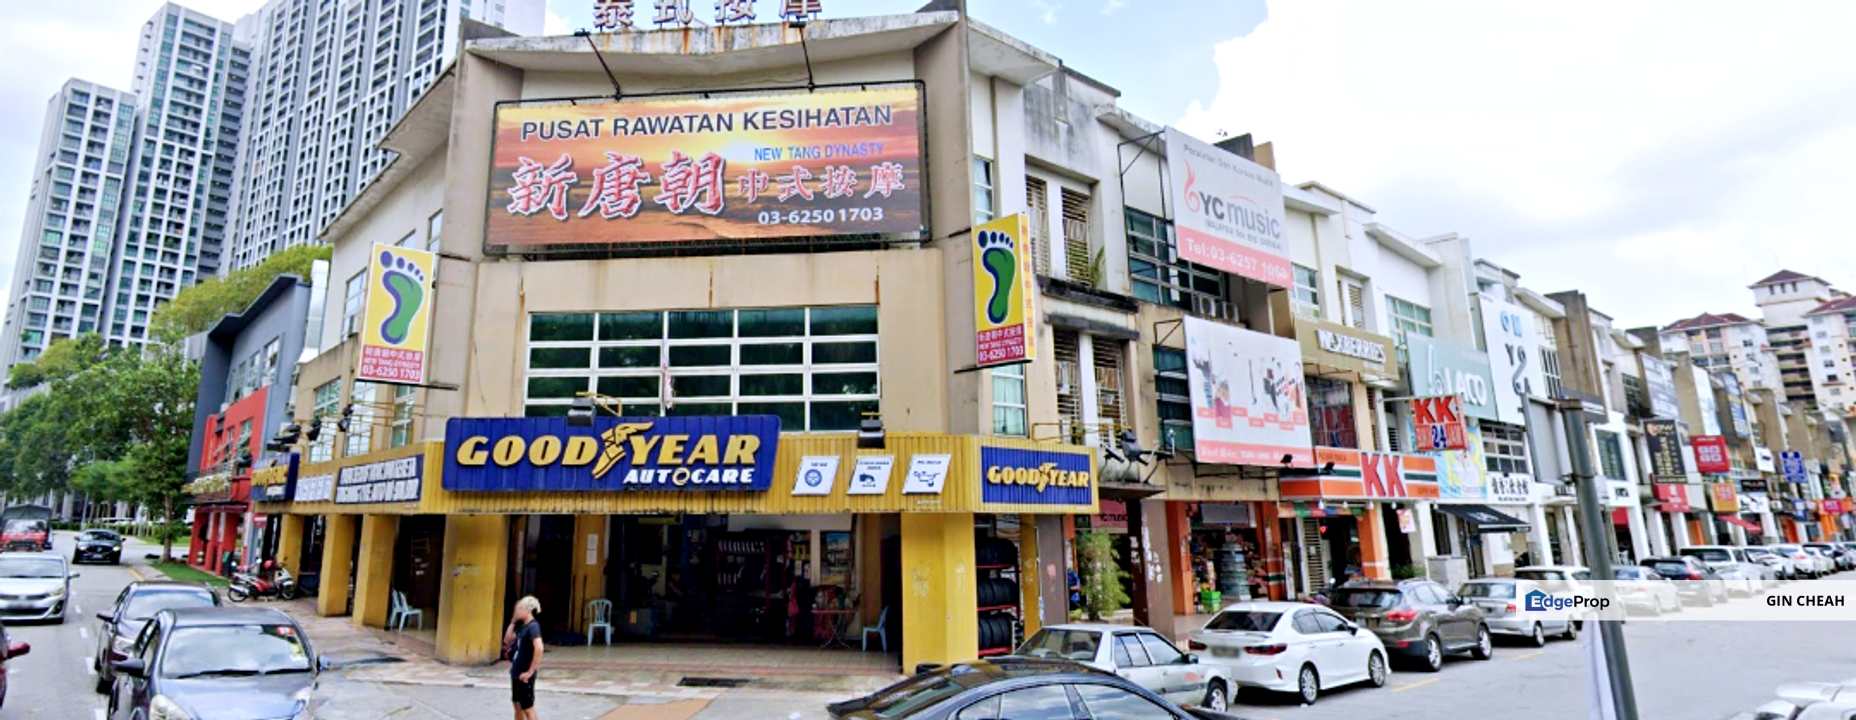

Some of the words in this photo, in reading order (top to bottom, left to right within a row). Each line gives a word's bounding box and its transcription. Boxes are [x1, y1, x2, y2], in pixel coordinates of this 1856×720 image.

[521, 118, 604, 142] PUSAT
[611, 111, 734, 136] RAWATAN
[743, 104, 893, 131] KESIHATAN
[754, 146, 783, 161] NEW
[787, 144, 822, 160] TANG
[825, 142, 884, 158] DYNASTY
[507, 151, 727, 221] 新唐朝
[737, 161, 906, 202] 中式按摩
[758, 208, 835, 225] 03-6250
[838, 206, 884, 222] 1703
[1198, 190, 1225, 220] YC
[1227, 201, 1281, 239] music
[363, 365, 398, 377] 03-6250
[400, 367, 421, 380] 1703
[1414, 396, 1456, 424] KK
[1432, 424, 1447, 449] 24
[987, 465, 1089, 488] GOODYEAR
[1361, 452, 1407, 498] KK
